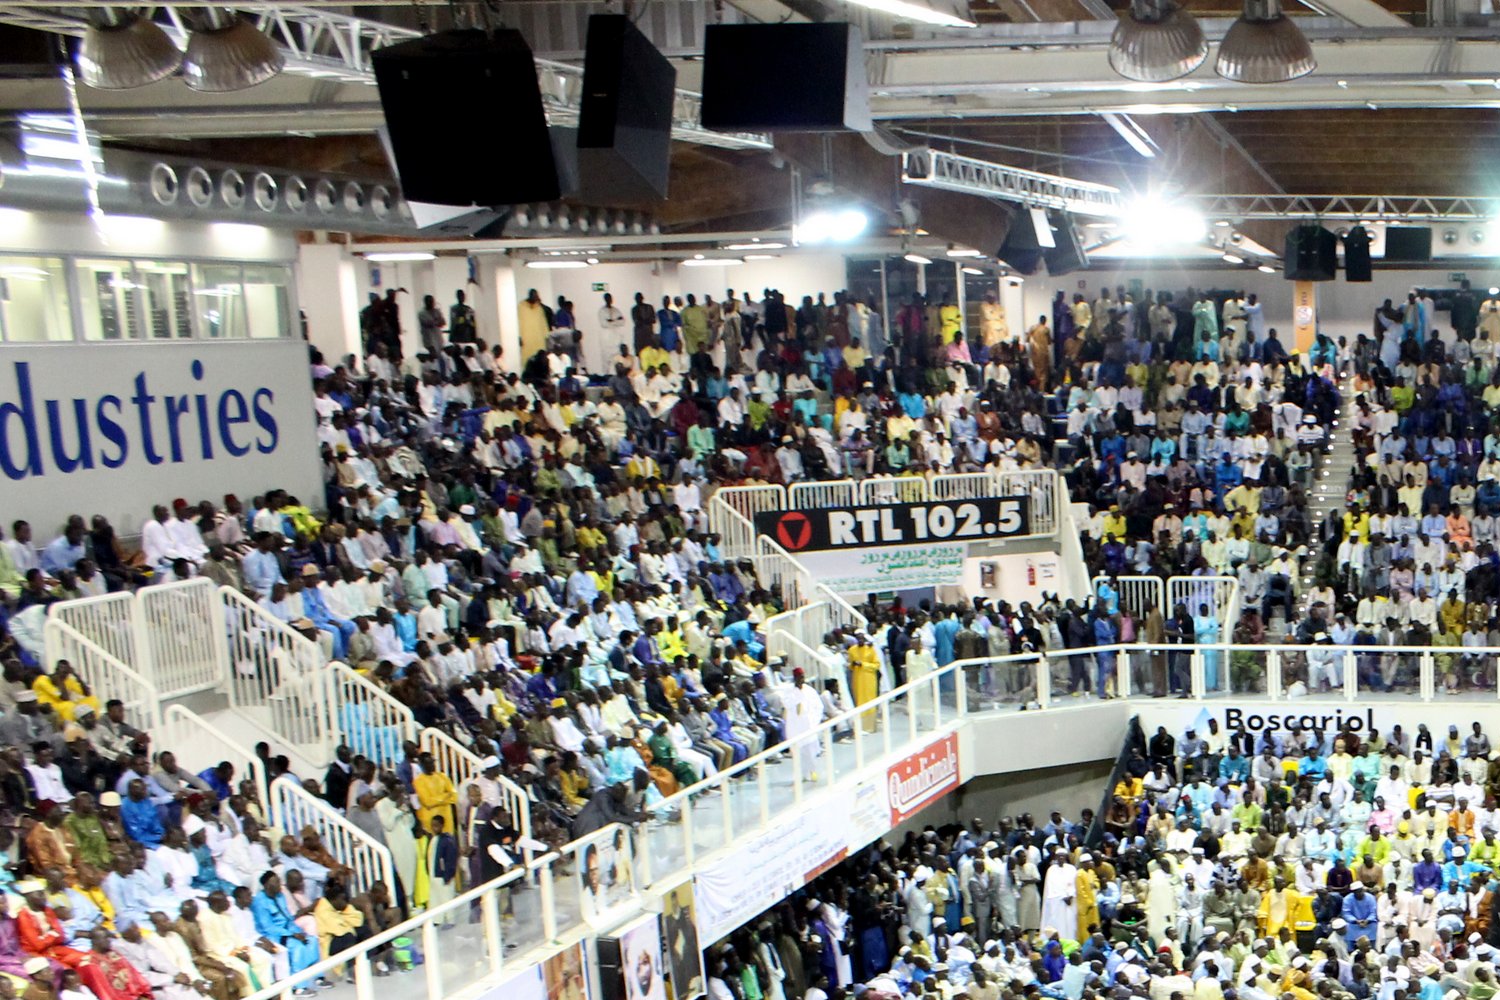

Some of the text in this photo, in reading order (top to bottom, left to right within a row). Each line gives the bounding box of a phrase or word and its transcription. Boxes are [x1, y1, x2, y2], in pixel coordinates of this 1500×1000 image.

[0, 359, 278, 480] dustries
[828, 501, 1022, 545] RTL 102.5
[1225, 708, 1374, 732] Boscariol
